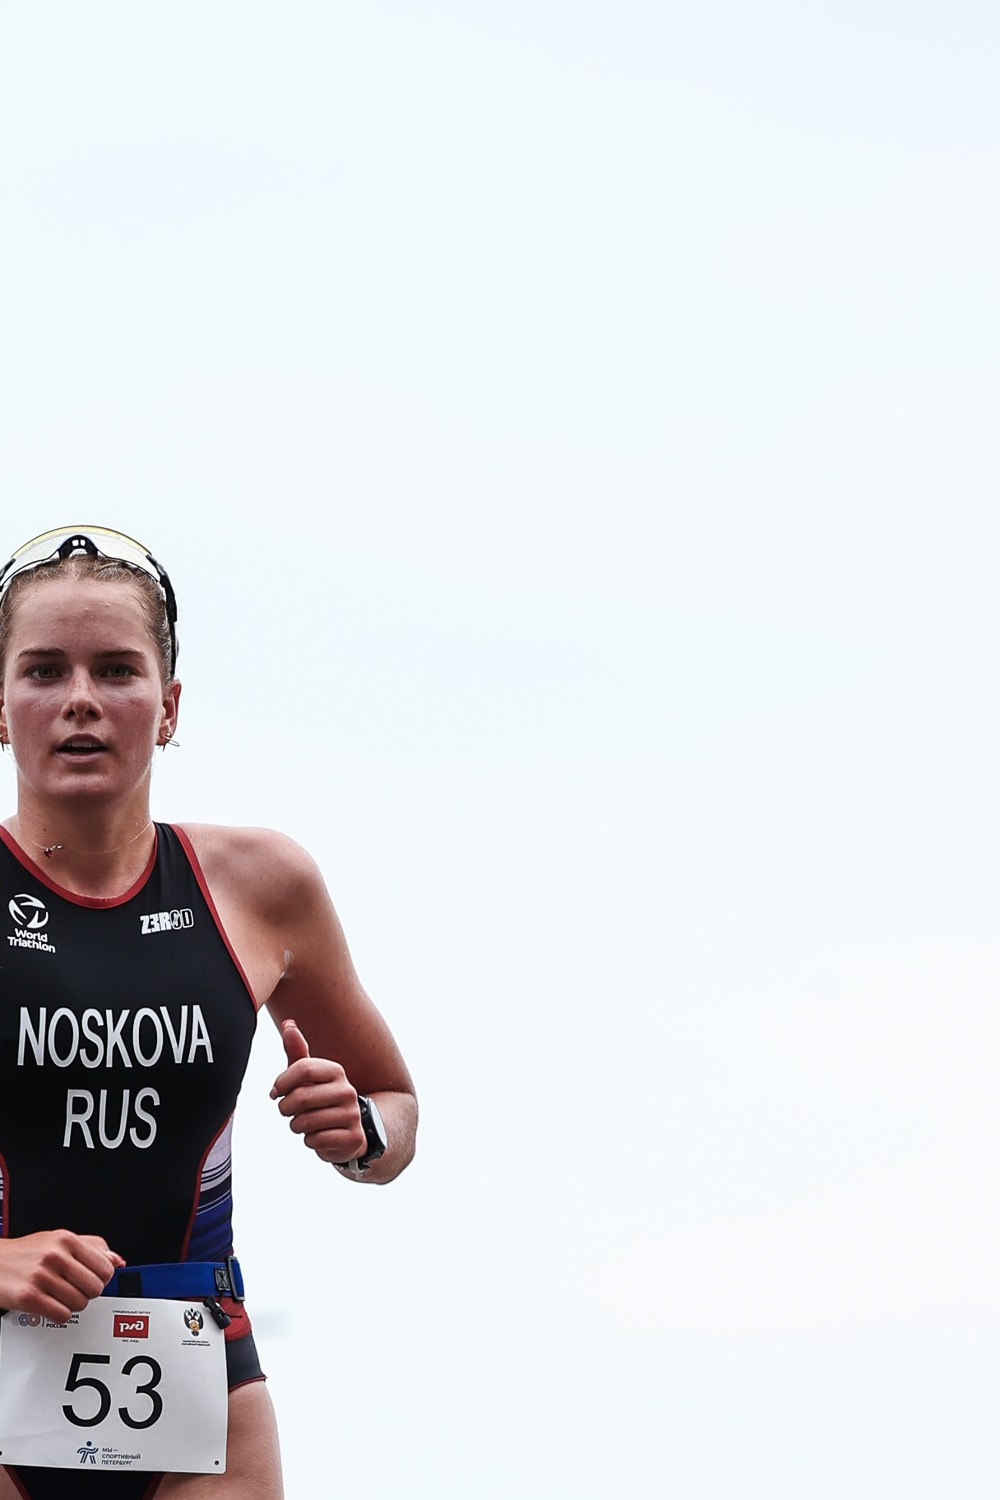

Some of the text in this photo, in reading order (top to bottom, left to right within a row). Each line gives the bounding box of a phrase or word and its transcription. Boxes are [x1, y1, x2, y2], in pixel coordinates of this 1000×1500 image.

[7, 936, 56, 953] Triathlon
[14, 928, 48, 943] World
[17, 1004, 214, 1069] NOSKOVA
[63, 1087, 161, 1149] RUS
[62, 1353, 163, 1430] 53
